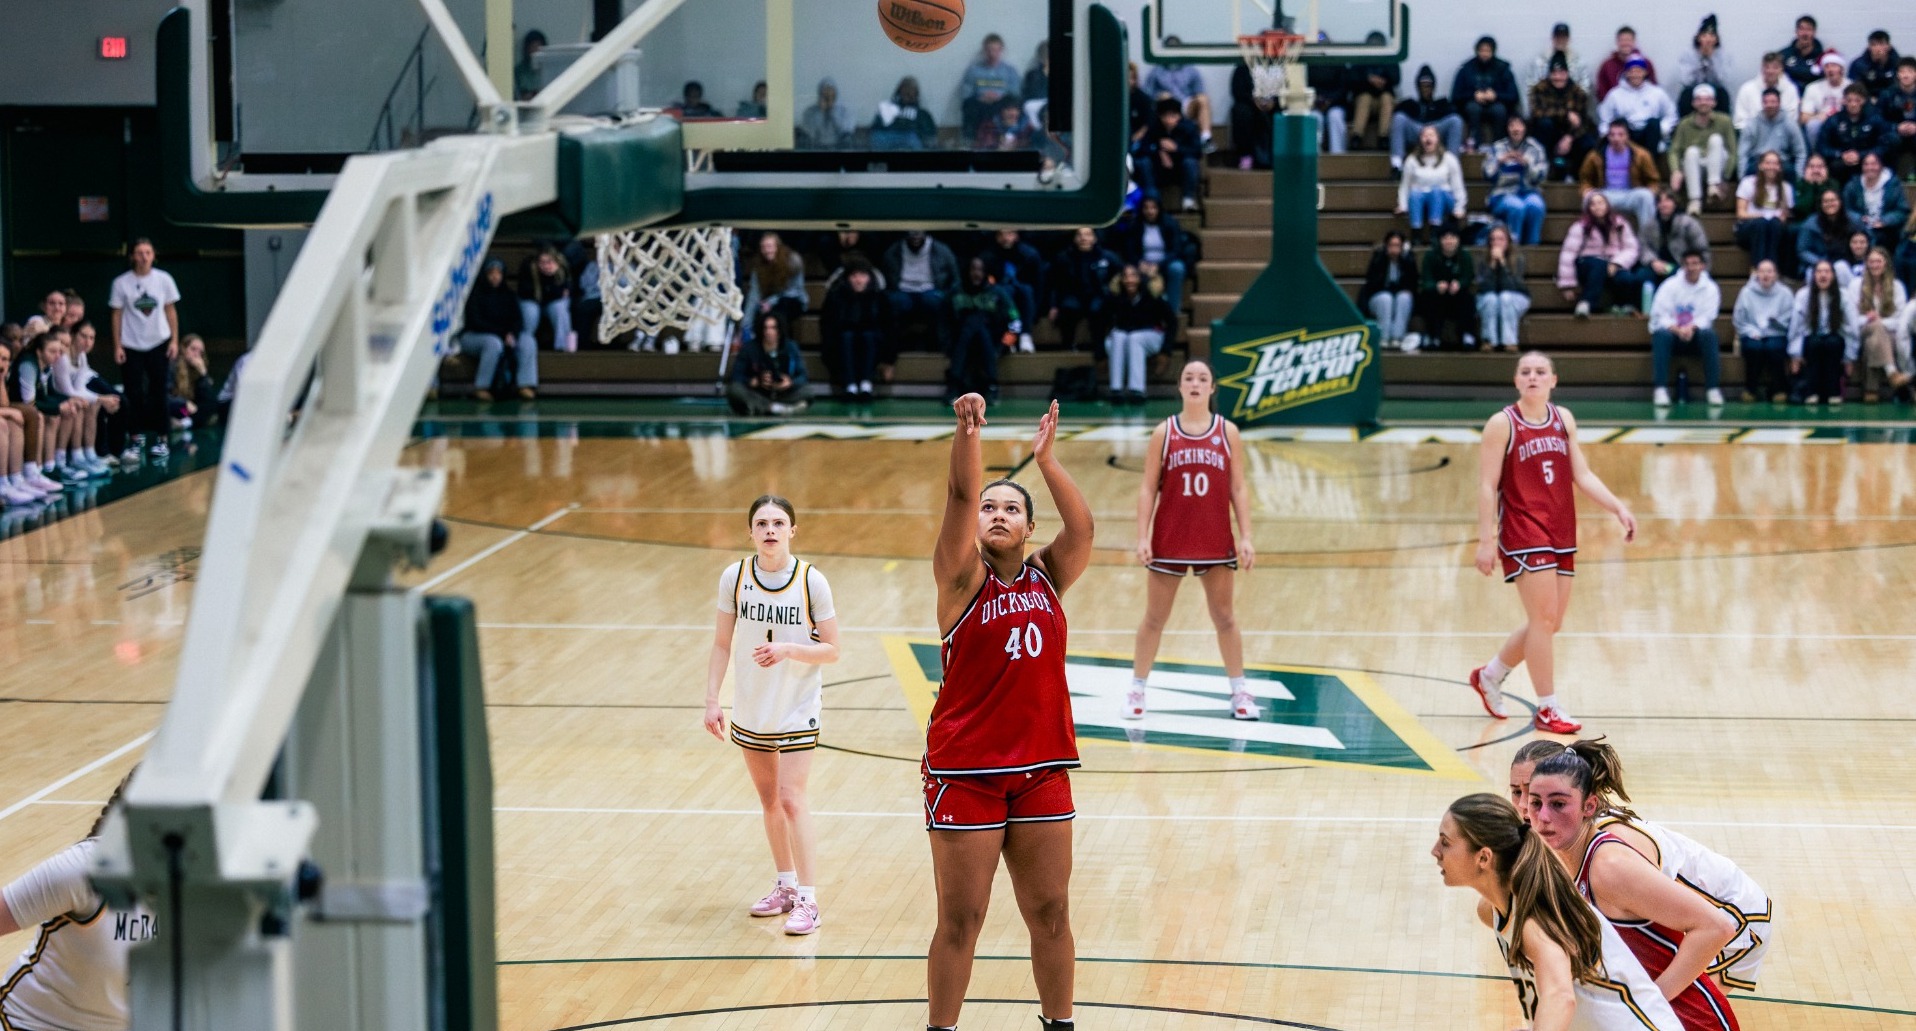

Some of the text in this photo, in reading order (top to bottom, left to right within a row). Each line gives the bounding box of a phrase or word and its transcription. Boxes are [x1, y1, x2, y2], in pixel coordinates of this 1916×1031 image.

[890, 3, 946, 30] Wilson
[1255, 332, 1362, 375] Green
[1245, 351, 1366, 407] Terror
[1182, 471, 1210, 497] 10
[1541, 460, 1554, 485] 5
[1004, 621, 1042, 660] 40
